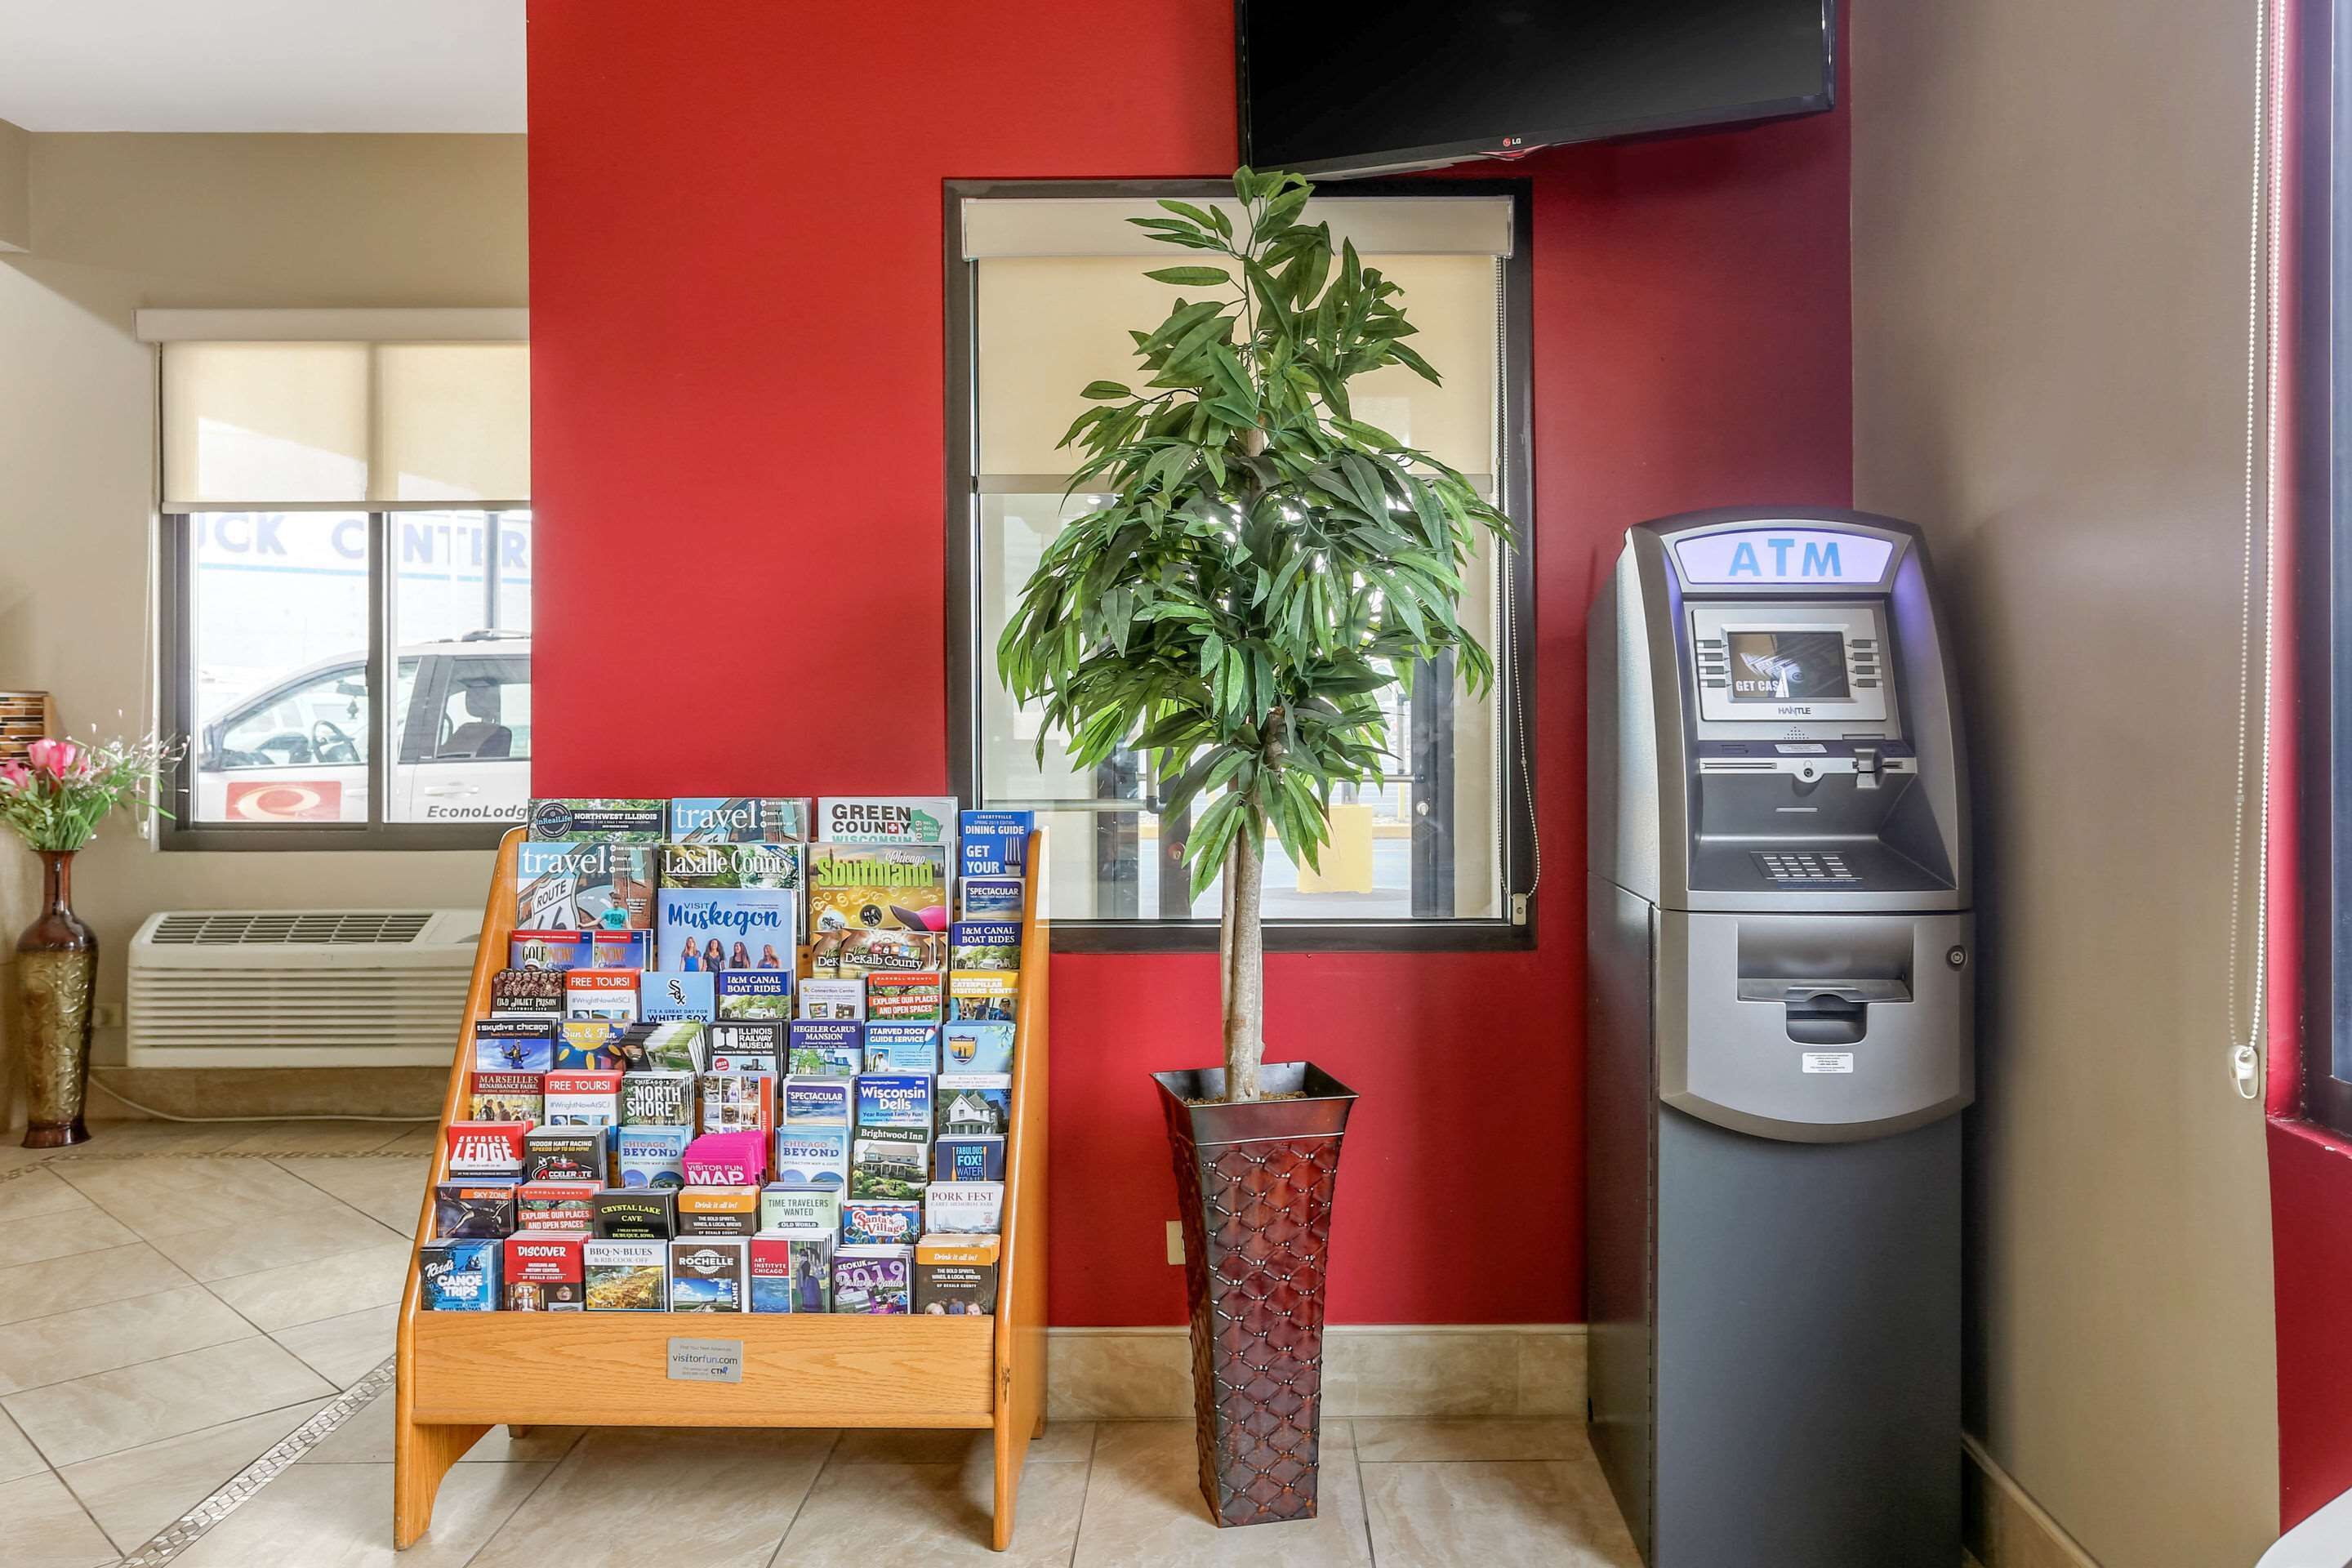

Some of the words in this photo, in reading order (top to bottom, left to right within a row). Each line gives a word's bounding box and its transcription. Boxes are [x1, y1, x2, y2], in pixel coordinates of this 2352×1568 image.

[1729, 538, 1842, 577] ATM
[1735, 680, 1756, 692] GET
[1757, 680, 1780, 692] CAS
[1778, 706, 1811, 715] HANTLE
[427, 805, 528, 820] EconoLodg
[675, 800, 758, 829] travel
[832, 804, 911, 822] GREEN
[965, 826, 996, 835] DINING
[998, 826, 1024, 835] GUIDE
[966, 845, 990, 858] GET
[523, 845, 607, 874] travel
[665, 849, 728, 874] LaSalle
[731, 849, 791, 878] County
[885, 849, 927, 867] Chicago
[817, 857, 933, 888] Southland
[967, 862, 1000, 874] YOUR
[537, 880, 567, 908] ROUTE
[668, 901, 782, 936] Muskegon
[522, 946, 546, 962] GOLF
[845, 953, 882, 965] DeKalb
[884, 956, 923, 970] County
[571, 978, 593, 987] FREE
[596, 978, 630, 987] TOURS!
[497, 997, 508, 1006] OLD
[511, 997, 534, 1007] JOLIET
[536, 997, 557, 1006] PRISON
[482, 1023, 514, 1032] skydive
[517, 1022, 549, 1033] chicago
[563, 1028, 581, 1039] Sun
[584, 1029, 594, 1038] &
[597, 1028, 617, 1039] Fun
[479, 1076, 539, 1084] MARSEILLES
[549, 1081, 571, 1090] FREE
[575, 1081, 610, 1090] TOURS!
[635, 1086, 681, 1102] NORTH
[860, 1086, 926, 1098] Wisconsin
[626, 1102, 674, 1117] SHORE
[880, 1098, 911, 1110] Dells
[861, 1128, 908, 1139] Brightwood
[909, 1131, 924, 1141] Inn
[452, 1143, 514, 1161] LEDGE
[623, 1148, 678, 1157] BEYOND
[784, 1148, 839, 1157] BEYOND
[956, 1146, 983, 1155] FABULOUS
[958, 1156, 982, 1166] FOX!
[956, 1167, 984, 1176] WATER
[688, 1171, 744, 1185] MAP
[932, 1192, 963, 1201] PORK
[968, 1192, 993, 1201] FEST
[768, 1199, 786, 1207] TIME
[788, 1199, 829, 1207] TRAVELERS
[521, 1212, 550, 1220] EXPLORE
[601, 1205, 637, 1214] CRYSTAL
[639, 1205, 661, 1215] LAKE
[528, 1221, 540, 1229] AND
[560, 1220, 584, 1228] SPACES
[853, 1211, 894, 1229] Santa's
[866, 1224, 905, 1235] Village
[517, 1246, 566, 1257] DISCOVER
[679, 1257, 734, 1266] ROCHELLE
[837, 1260, 868, 1271] KEOKUK
[437, 1274, 483, 1287] CANOE
[835, 1261, 905, 1296] 2019
[443, 1286, 478, 1297] TRIPS
[673, 1353, 738, 1365] visitorfun.com
